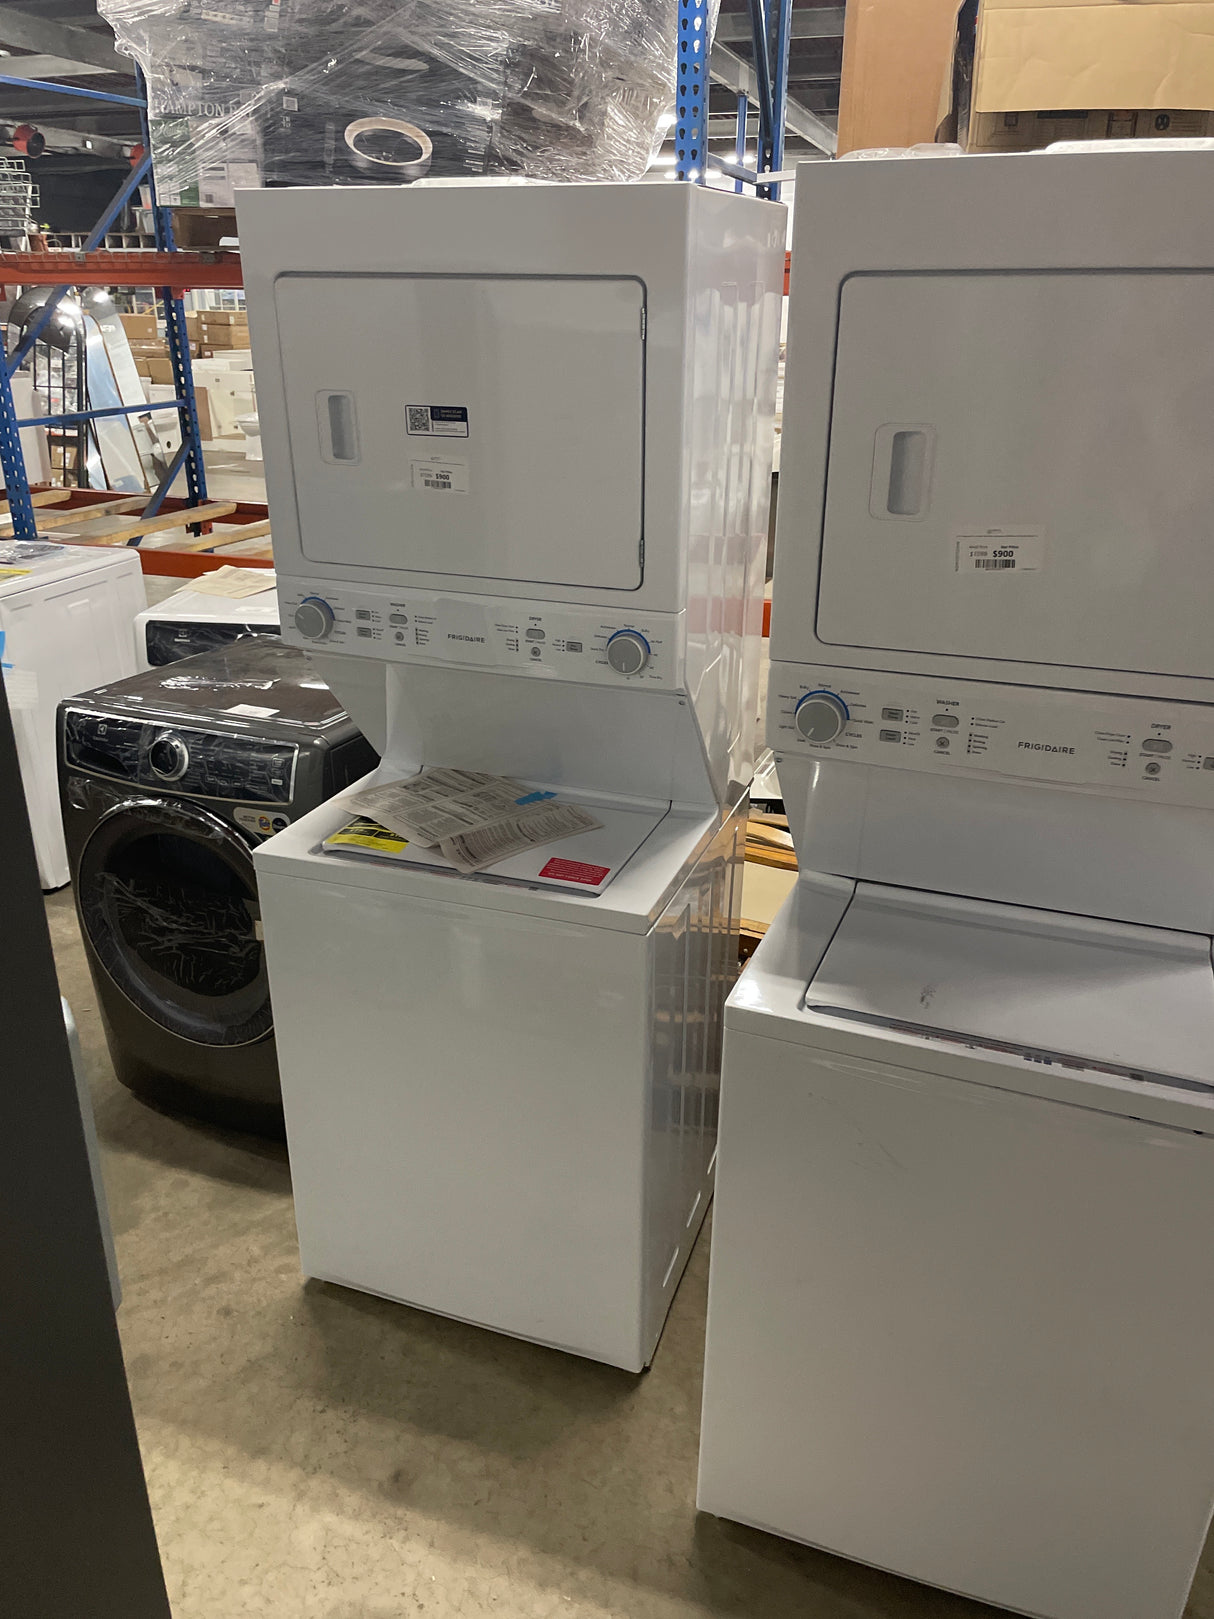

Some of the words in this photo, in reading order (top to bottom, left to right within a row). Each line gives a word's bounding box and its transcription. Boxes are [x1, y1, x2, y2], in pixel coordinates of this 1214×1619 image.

[993, 550, 1014, 558] $900
[447, 633, 486, 643] FRIGIDAIRE
[1017, 741, 1076, 755] FRIGIDAIRE
